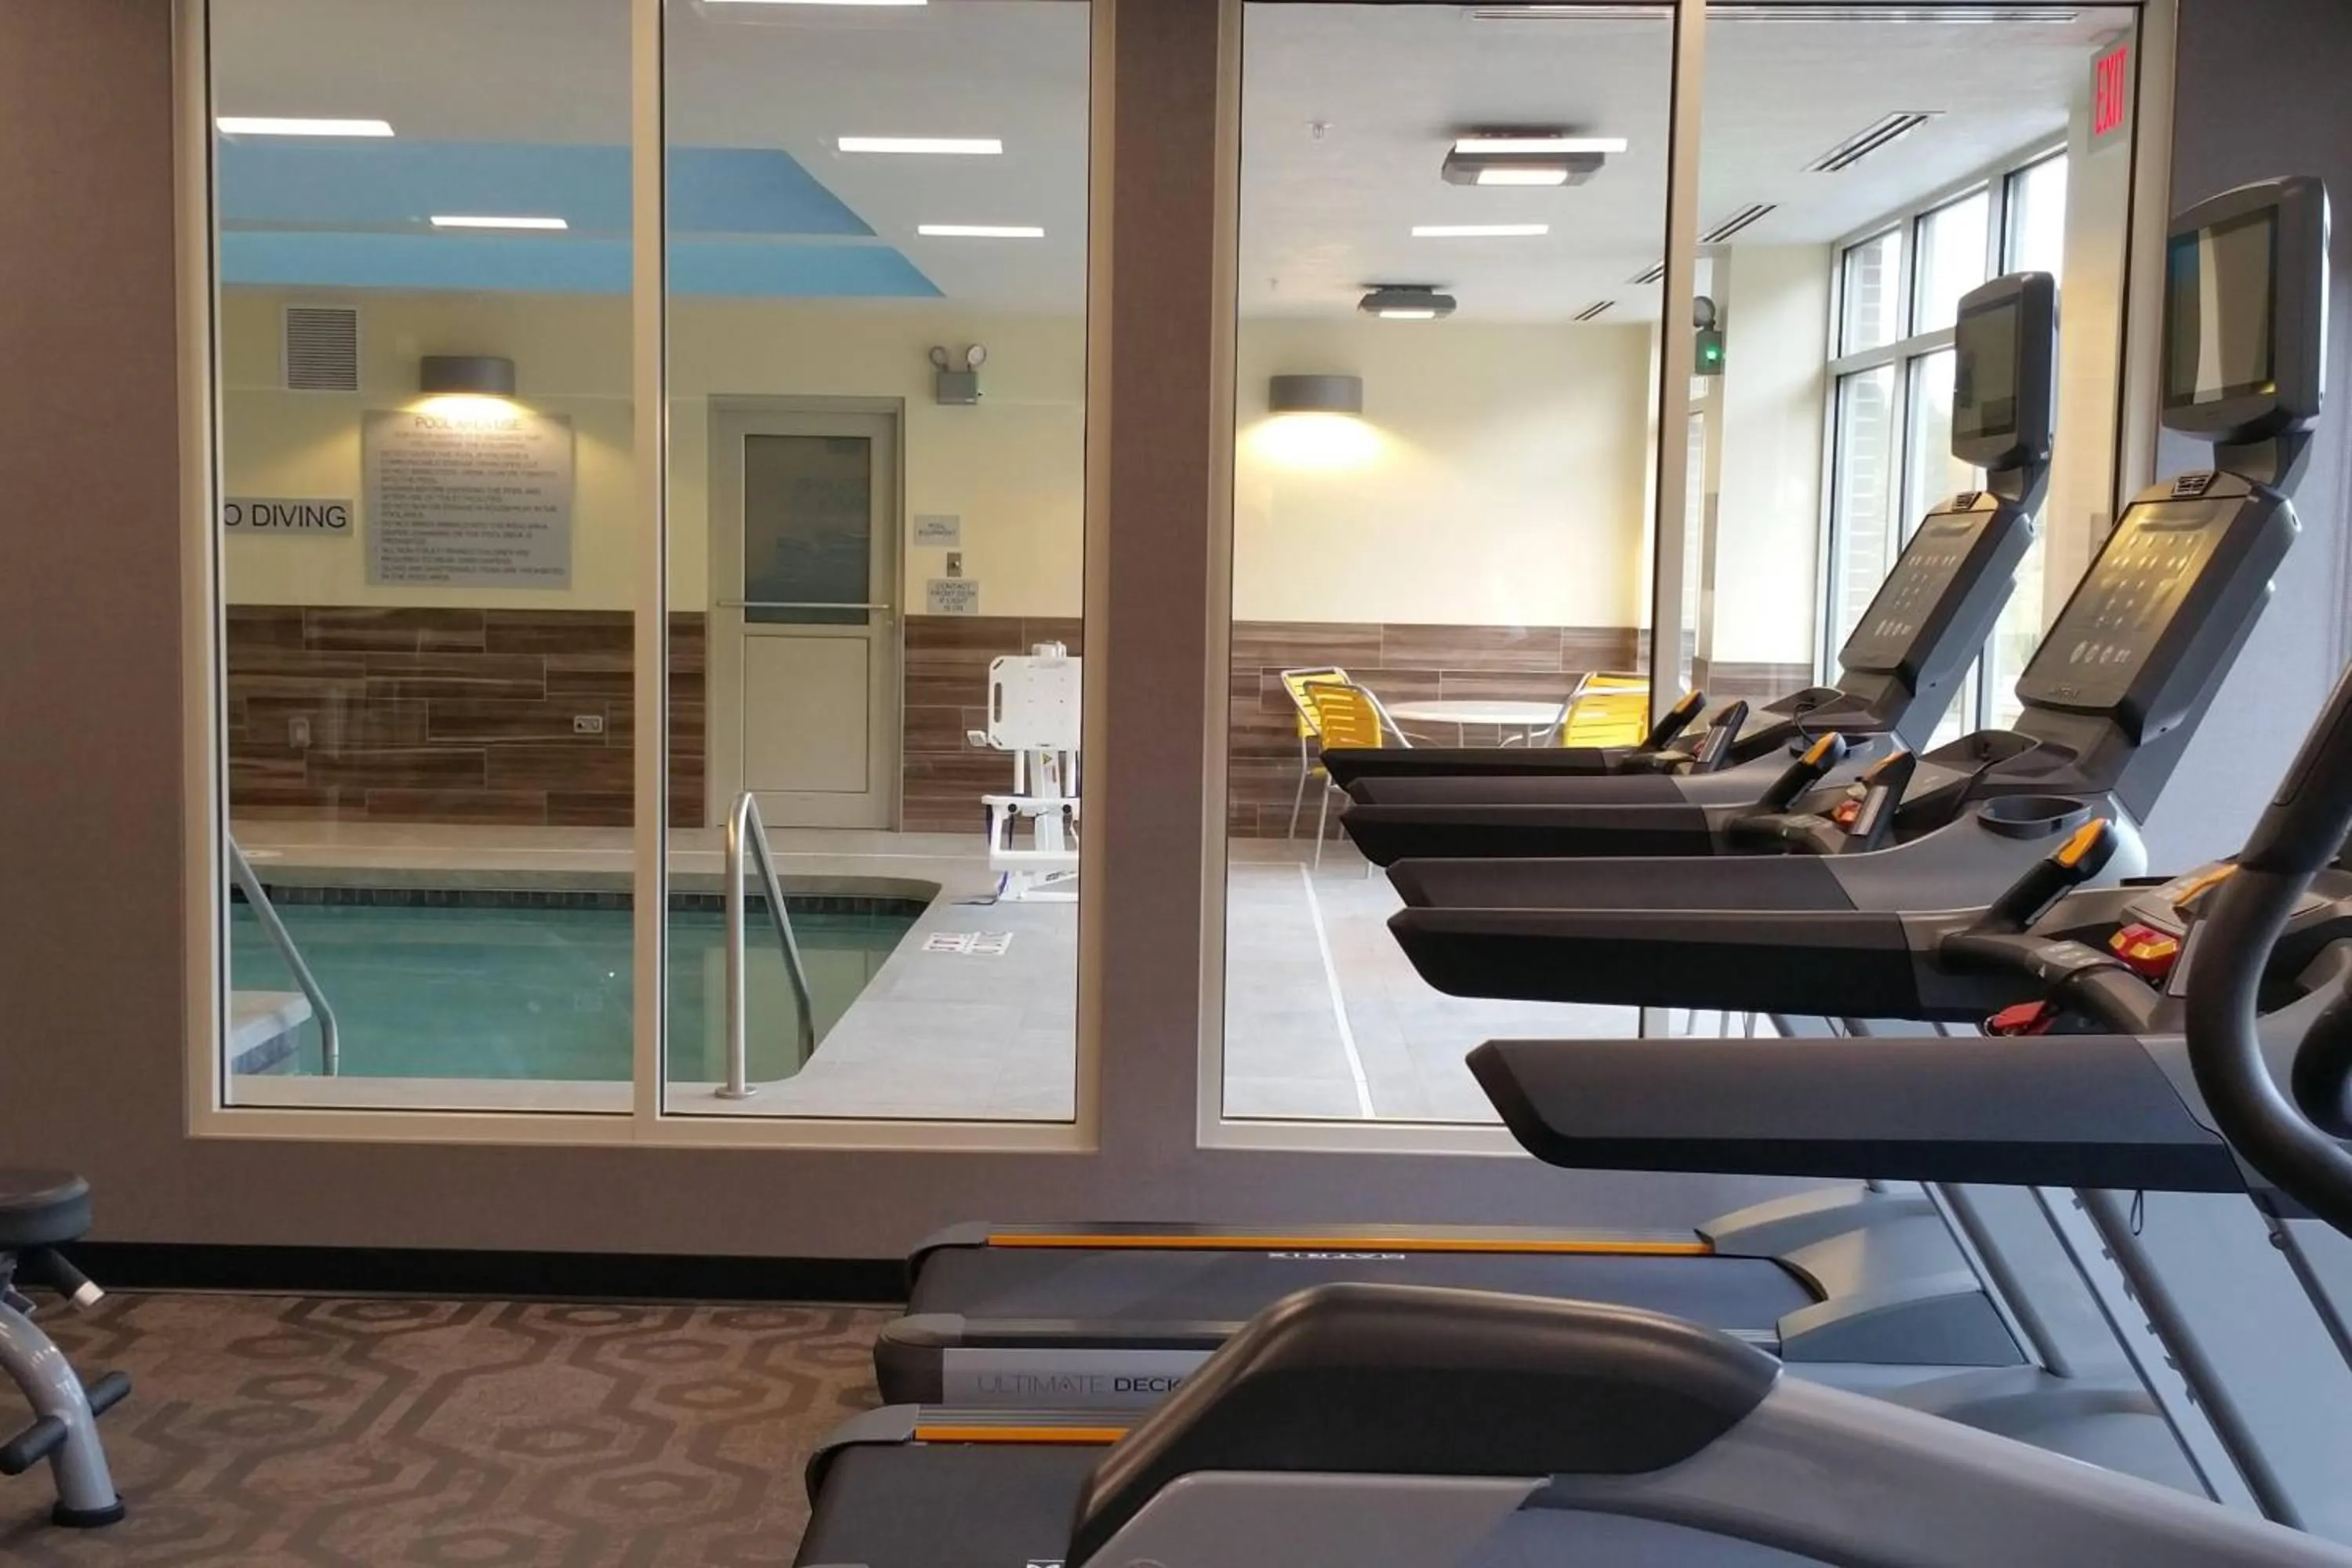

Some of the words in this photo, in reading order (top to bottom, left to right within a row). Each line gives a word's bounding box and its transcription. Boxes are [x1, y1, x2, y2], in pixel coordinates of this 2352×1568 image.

[2096, 46, 2127, 135] EXIT
[224, 503, 241, 526] O
[252, 504, 347, 528] DIVING
[976, 1375, 1103, 1394] ULTIMATE
[1114, 1377, 1179, 1392] DECK
